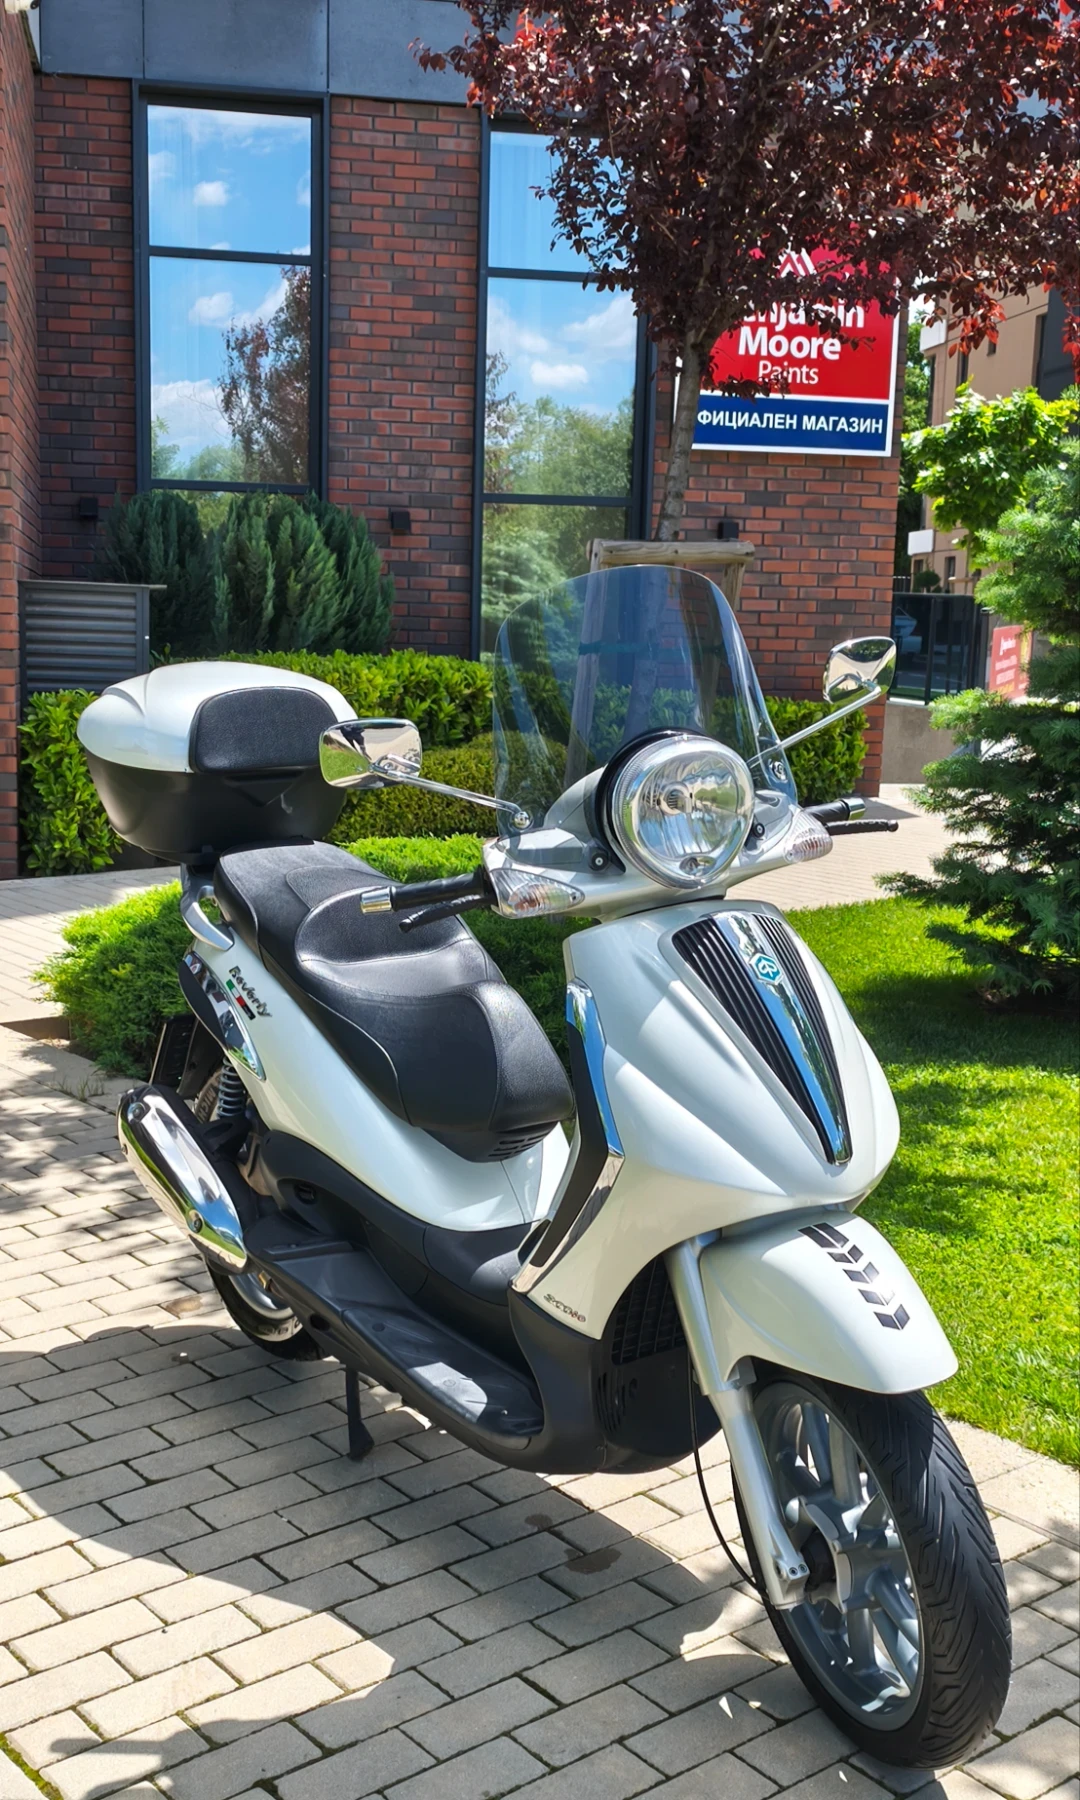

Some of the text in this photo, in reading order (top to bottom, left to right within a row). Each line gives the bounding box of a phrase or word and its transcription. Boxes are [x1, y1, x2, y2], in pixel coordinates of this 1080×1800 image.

[742, 298, 865, 333] njain
[738, 325, 842, 360] Moore
[697, 409, 883, 434] ФИЦИАЛЕН МАГАЗИН
[228, 965, 272, 1018] Beverly
